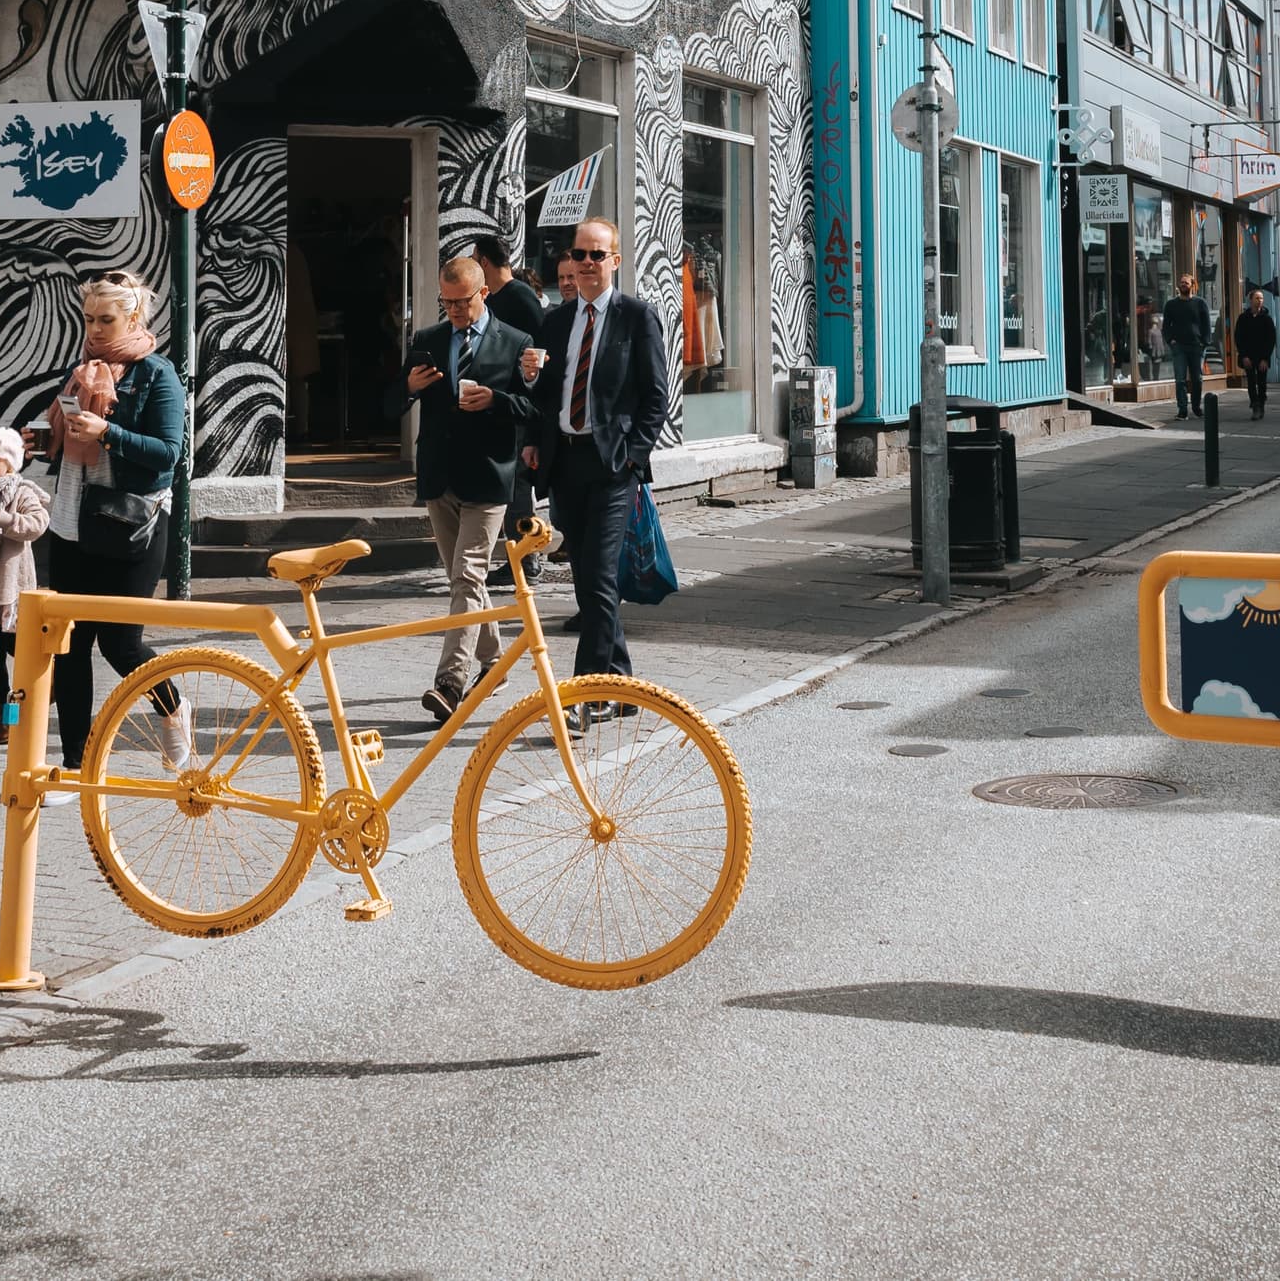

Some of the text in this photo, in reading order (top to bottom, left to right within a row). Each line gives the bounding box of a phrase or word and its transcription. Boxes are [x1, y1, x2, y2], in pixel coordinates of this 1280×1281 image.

[550, 193, 586, 206] TAX FREE
[545, 205, 583, 217] SHOPPING
